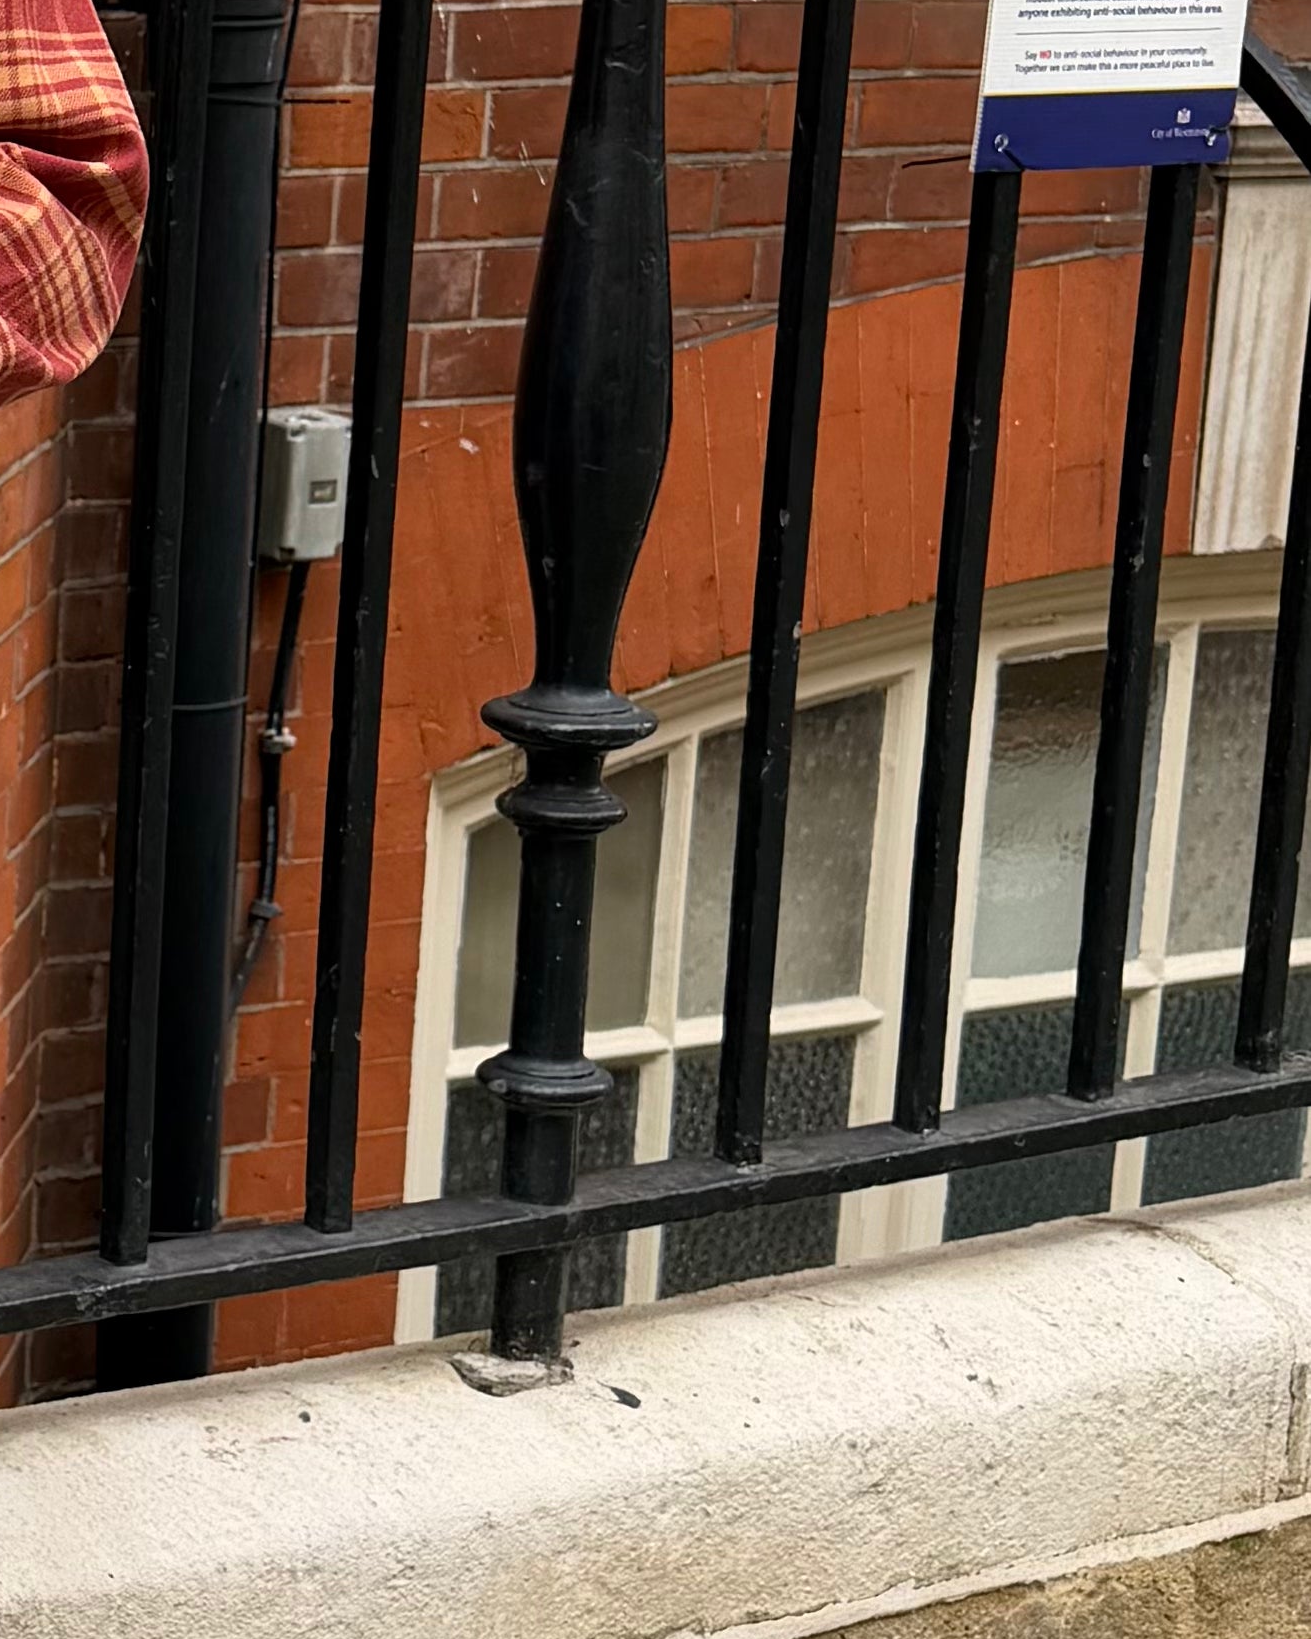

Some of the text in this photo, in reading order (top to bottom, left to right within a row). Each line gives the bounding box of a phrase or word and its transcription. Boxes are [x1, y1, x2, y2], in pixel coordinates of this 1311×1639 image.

[1018, 10, 1048, 20] anyone
[1051, 7, 1091, 18] exhibiting
[1093, 6, 1135, 15] anti-social
[1138, 6, 1177, 15] behaviour
[1179, 6, 1186, 14] in
[1189, 5, 1203, 13] this
[1025, 50, 1037, 61] Say
[1054, 50, 1061, 58] to
[1103, 49, 1139, 58] behaviour
[1149, 49, 1165, 58] your
[1015, 64, 1047, 74] Together
[1140, 60, 1170, 70] peaceful
[1172, 60, 1190, 70] place
